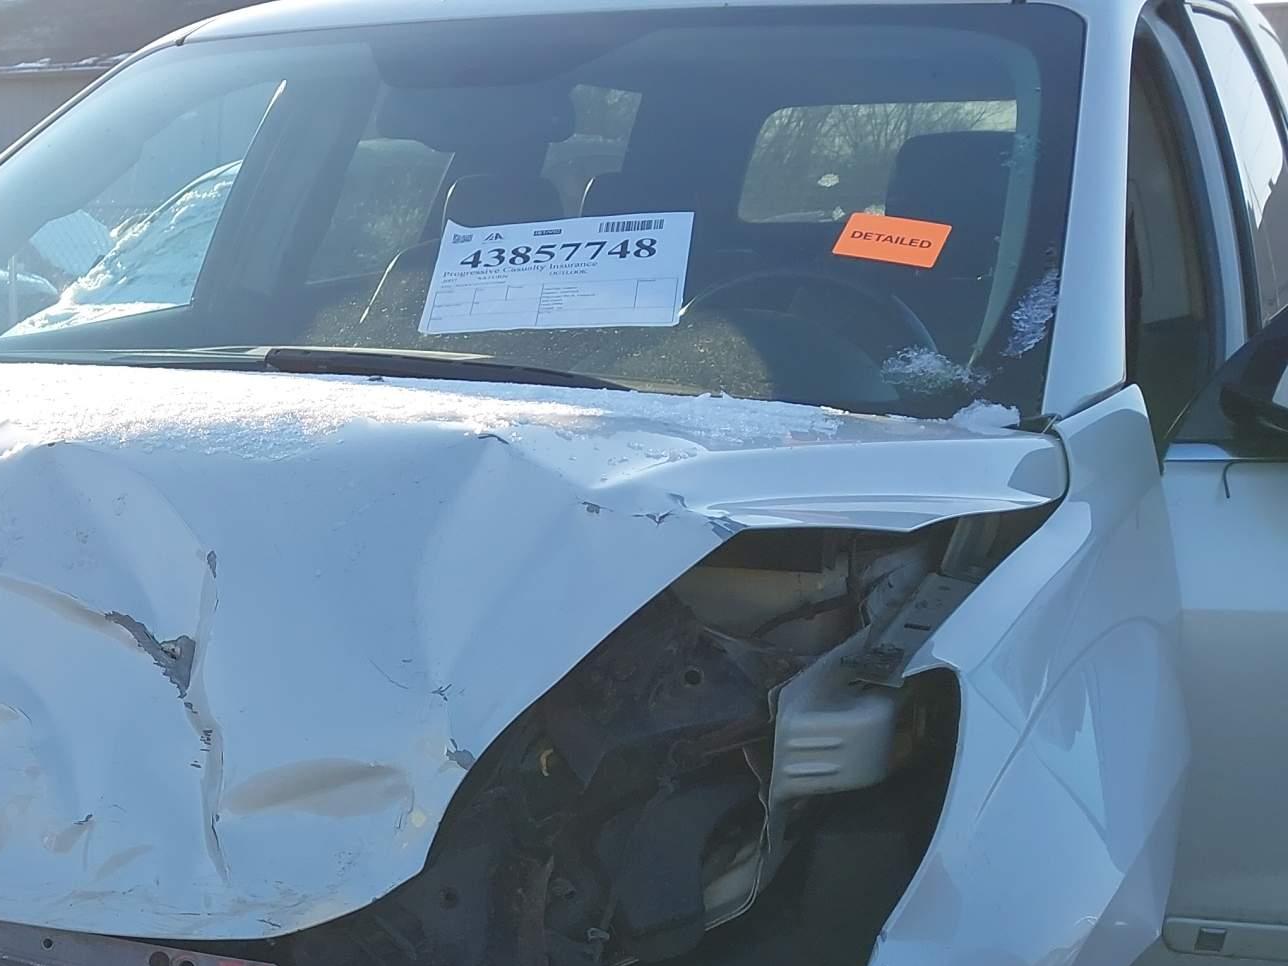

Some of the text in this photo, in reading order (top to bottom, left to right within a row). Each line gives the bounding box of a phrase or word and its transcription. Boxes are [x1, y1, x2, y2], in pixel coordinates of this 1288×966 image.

[850, 230, 932, 249] DETAILED
[459, 238, 658, 269] 43857748
[442, 261, 598, 278] Progressive Casualty Insurance
